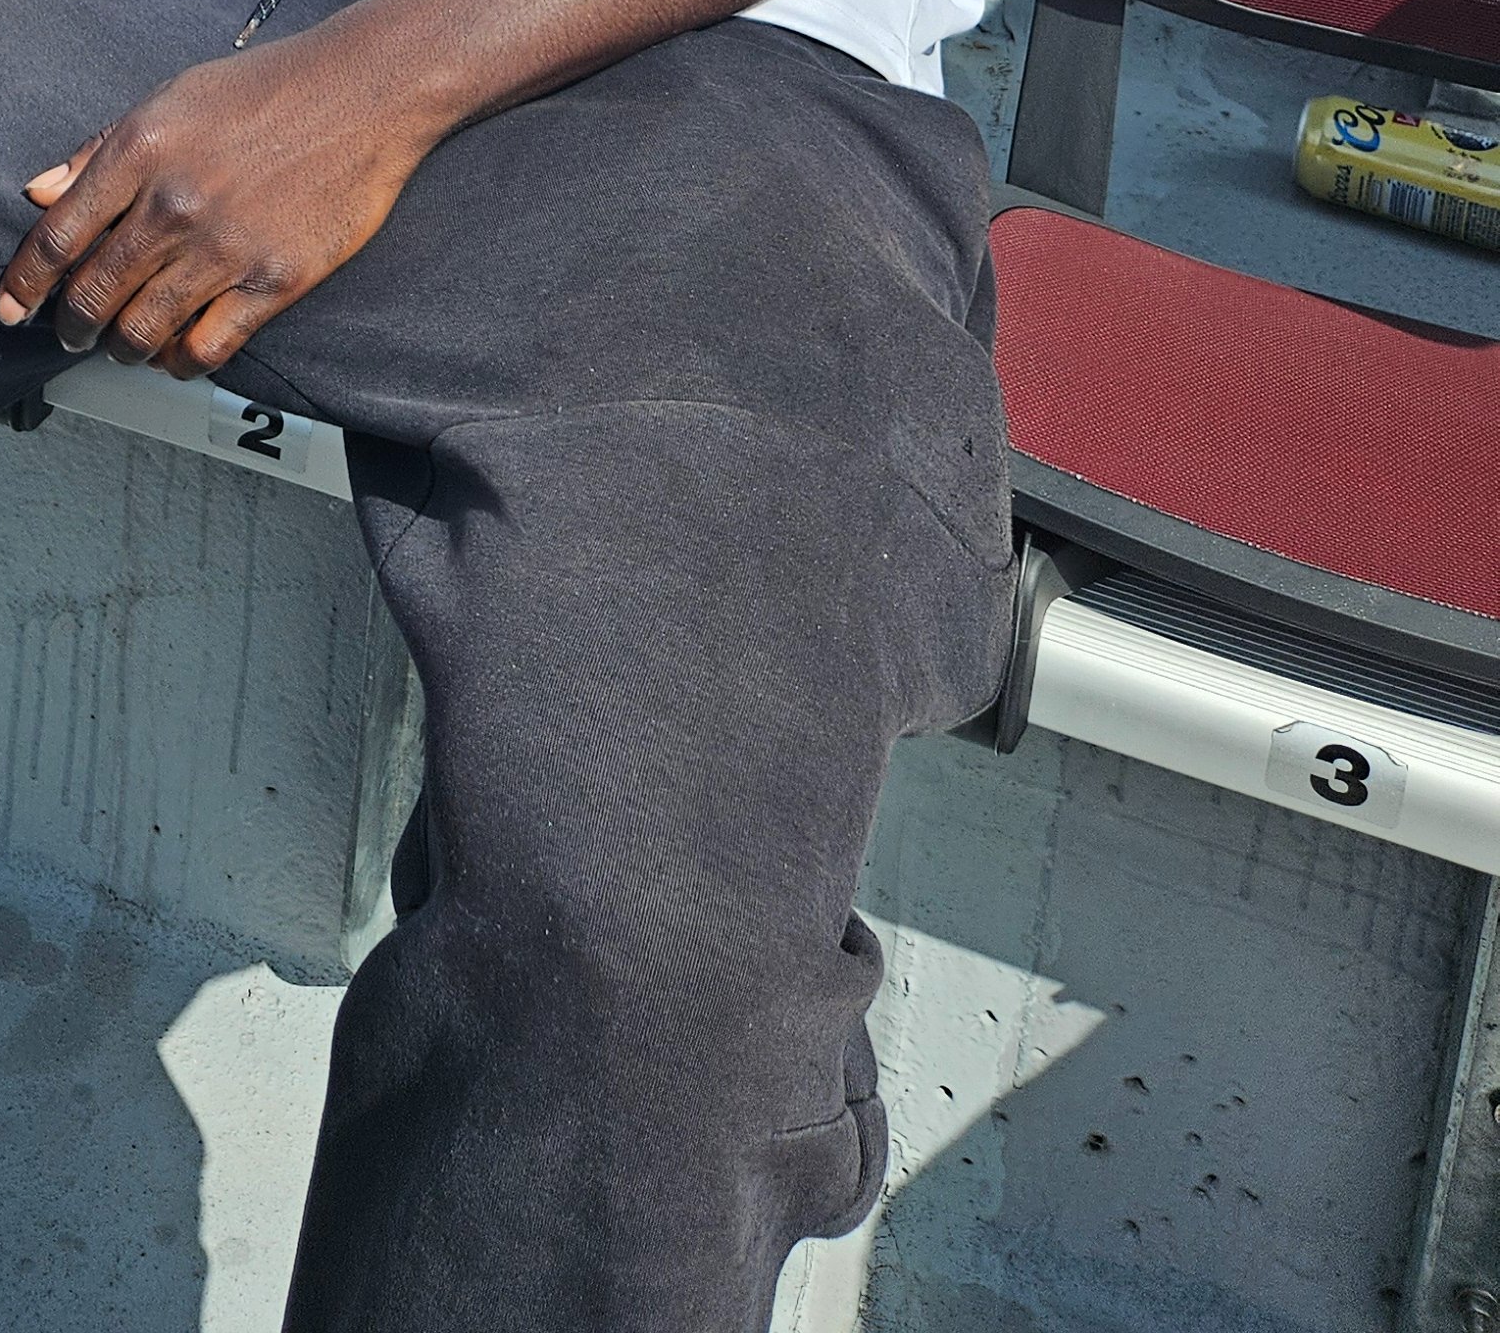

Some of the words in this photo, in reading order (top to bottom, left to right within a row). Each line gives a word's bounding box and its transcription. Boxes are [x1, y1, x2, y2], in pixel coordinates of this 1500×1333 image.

[1332, 103, 1389, 153] Co
[237, 404, 286, 461] 2
[1308, 743, 1372, 807] 3
